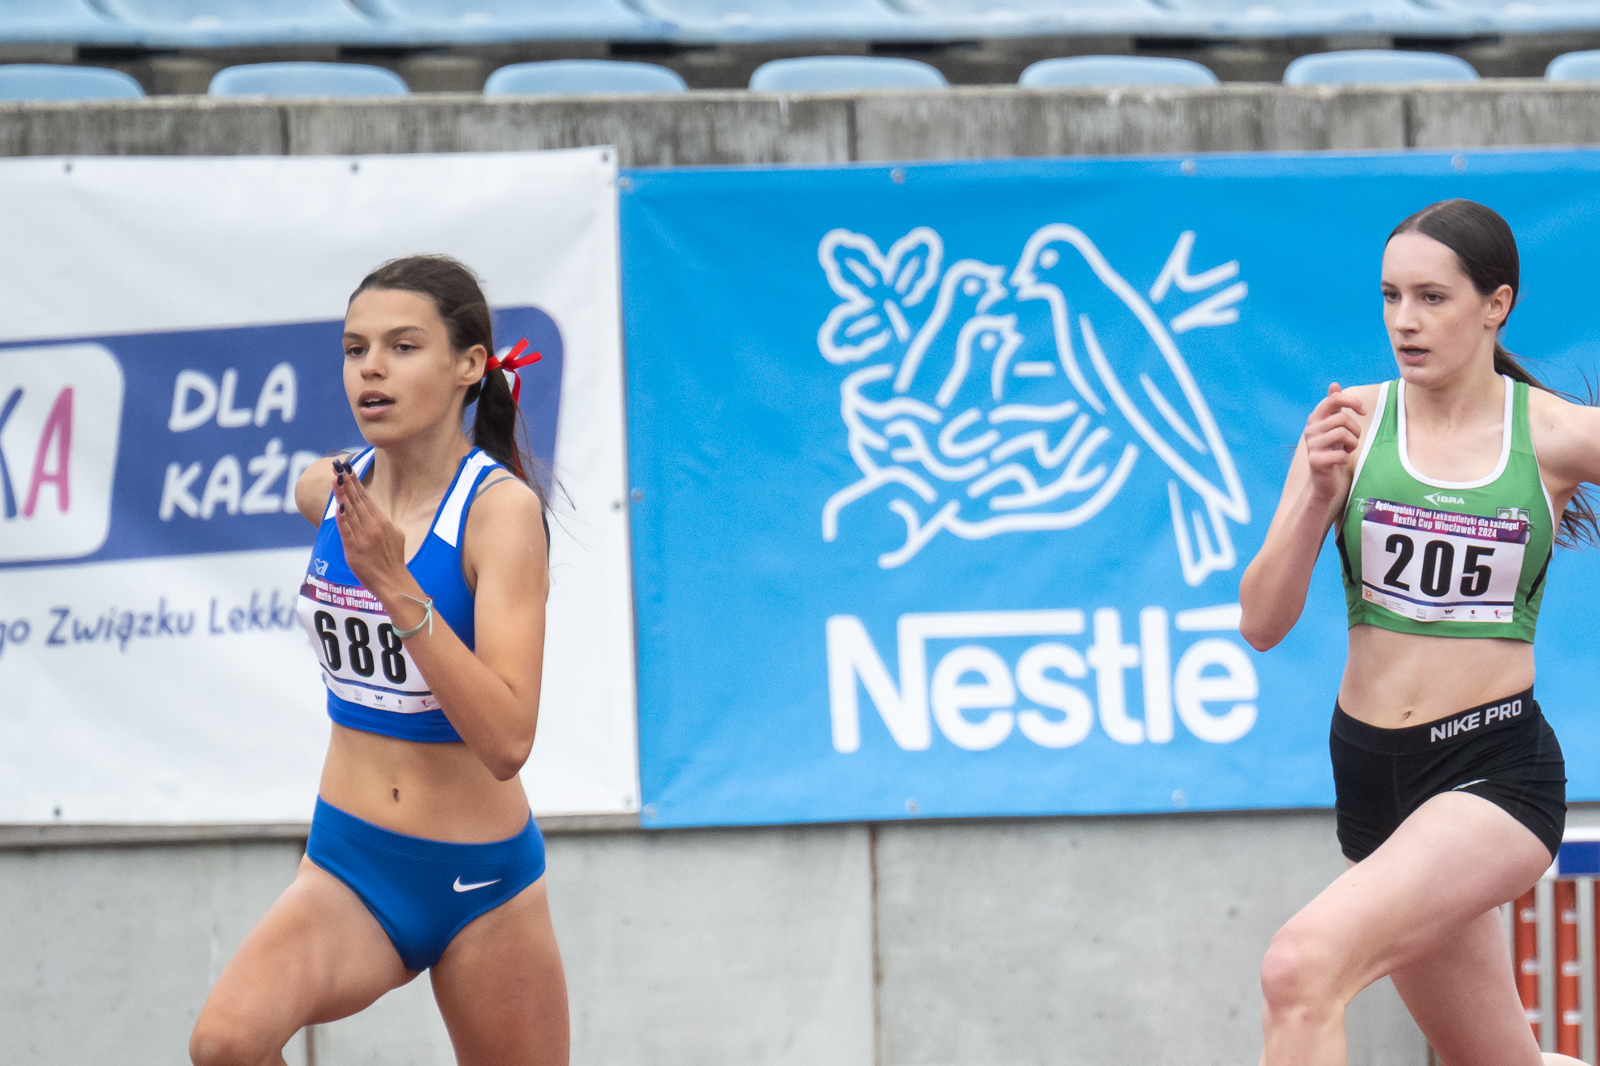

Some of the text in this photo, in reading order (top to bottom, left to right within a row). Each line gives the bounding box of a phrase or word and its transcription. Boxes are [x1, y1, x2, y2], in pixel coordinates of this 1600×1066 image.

[167, 361, 298, 433] DLA
[1417, 518, 1432, 529] Cup
[1478, 527, 1497, 538] 2024
[1478, 516, 1489, 527] dla
[1383, 533, 1496, 598] 205
[46, 594, 196, 655] Związku
[332, 594, 345, 606] Cup
[313, 610, 407, 684] 688
[825, 603, 1260, 754] Nestlé
[1430, 699, 1522, 743] NIKE PRO
